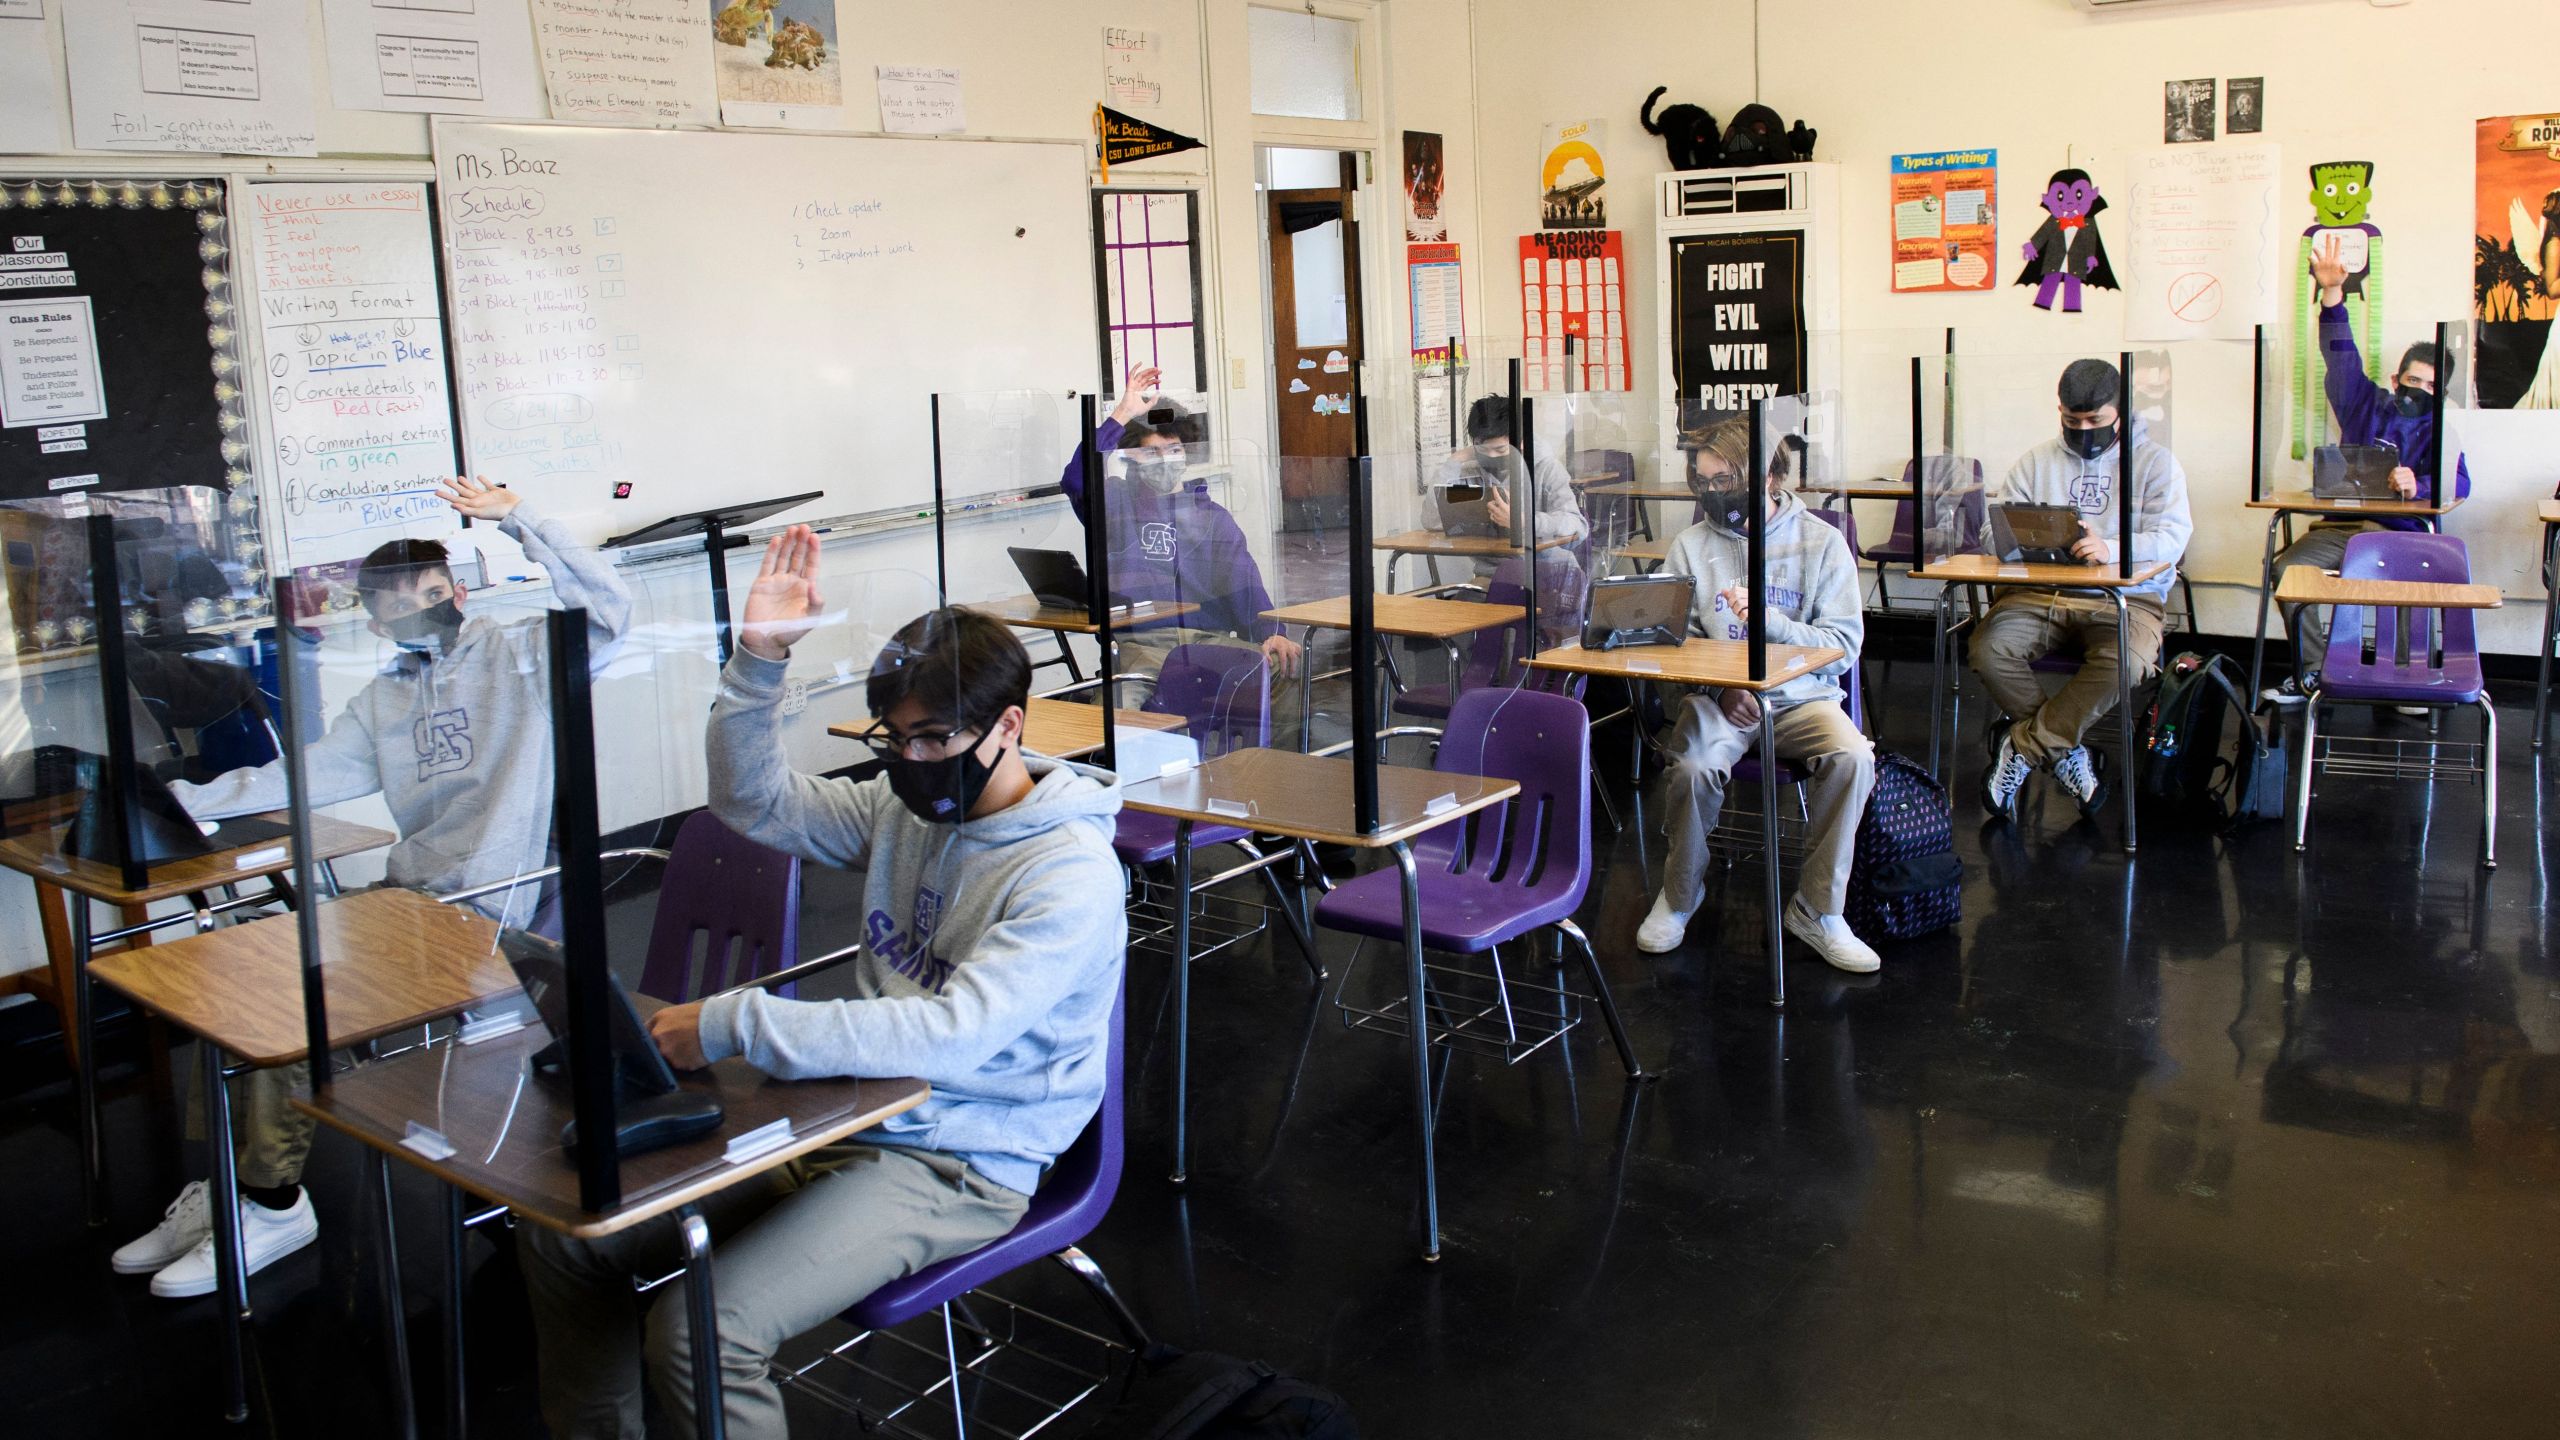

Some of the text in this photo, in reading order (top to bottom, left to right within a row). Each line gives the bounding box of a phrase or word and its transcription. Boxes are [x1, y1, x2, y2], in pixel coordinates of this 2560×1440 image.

[554, 1, 600, 16] motivation
[608, 8, 622, 22] Why
[624, 11, 637, 20] the
[142, 36, 174, 44] Antagonist
[543, 24, 650, 45] 5 monster Antagonist
[1106, 27, 1147, 49] Effort
[560, 49, 604, 62] protagonist
[1122, 54, 1130, 63] is
[549, 70, 647, 90] 7 Suspense exciting
[888, 66, 904, 77] How
[906, 68, 913, 77] to
[1107, 66, 1161, 104] Everything
[554, 89, 679, 108] 8 Gothic Elements meant
[881, 95, 926, 106] What the
[2189, 91, 2211, 105] HYDE
[658, 109, 680, 118] scare
[111, 112, 274, 134] Foil contrast with
[1122, 122, 1149, 136] Beach
[1561, 124, 1587, 138] SOLO
[160, 132, 201, 142] another
[1109, 148, 1122, 160] CSU
[1124, 145, 1144, 158] LONG
[1902, 152, 1988, 169] Types of Writing
[2149, 152, 2266, 169] Do NOT these
[456, 148, 560, 181] Ms. Boaz
[1897, 177, 1933, 185] Narrative
[257, 189, 420, 212] Never use in essay
[460, 192, 536, 218] Schedule
[806, 200, 882, 219] Check update
[259, 216, 324, 229] I think
[264, 234, 280, 246] I
[455, 228, 506, 248] 1st Block
[821, 228, 852, 240] Zoom
[1534, 230, 1607, 247] READING
[1731, 237, 1764, 246] BOURNES
[1945, 229, 1984, 238] Persuasive
[14, 237, 40, 249] Our
[1548, 243, 1602, 259] BINGO
[1898, 242, 1938, 252] Descriptive
[266, 245, 361, 264] In my opinion
[455, 254, 499, 269] Break
[818, 245, 880, 264] Independent
[889, 242, 915, 254] work
[1410, 247, 1455, 259] Punctuation
[265, 262, 335, 276] I believe
[1707, 262, 1765, 291] FIGHT
[0, 275, 75, 286] Constitution
[298, 274, 336, 285] belief
[458, 275, 512, 294] 2nd Block
[2178, 283, 2216, 304] NO
[264, 296, 338, 318] Writing
[460, 295, 518, 316] 3rd Block
[10, 314, 72, 324] Class Rules
[1714, 304, 1759, 331] EVIL
[14, 336, 78, 348] Be Respectful
[462, 327, 494, 344] lunch
[19, 353, 78, 364] Be Prepared
[298, 340, 434, 375] Topic in Blue
[466, 352, 527, 374] 3rd Block
[1709, 343, 1768, 371] WITH
[22, 370, 78, 380] Understand
[27, 381, 77, 391] and Follow
[295, 375, 437, 401] Concrete details in
[466, 378, 528, 399] 4th Block
[21, 391, 84, 402] Class Policies
[1700, 383, 1779, 411] POETRY
[333, 400, 370, 417] Red
[40, 429, 66, 438] NOPE
[304, 430, 392, 454] Commentary
[474, 424, 604, 455] Welcome Back
[43, 444, 61, 452] Late
[320, 452, 398, 472] in green
[528, 452, 592, 472] Saints
[67, 476, 98, 485] Phones
[306, 474, 444, 505] Concluding sentence
[338, 502, 405, 526] in Blue
[865, 910, 958, 995] SAINT
